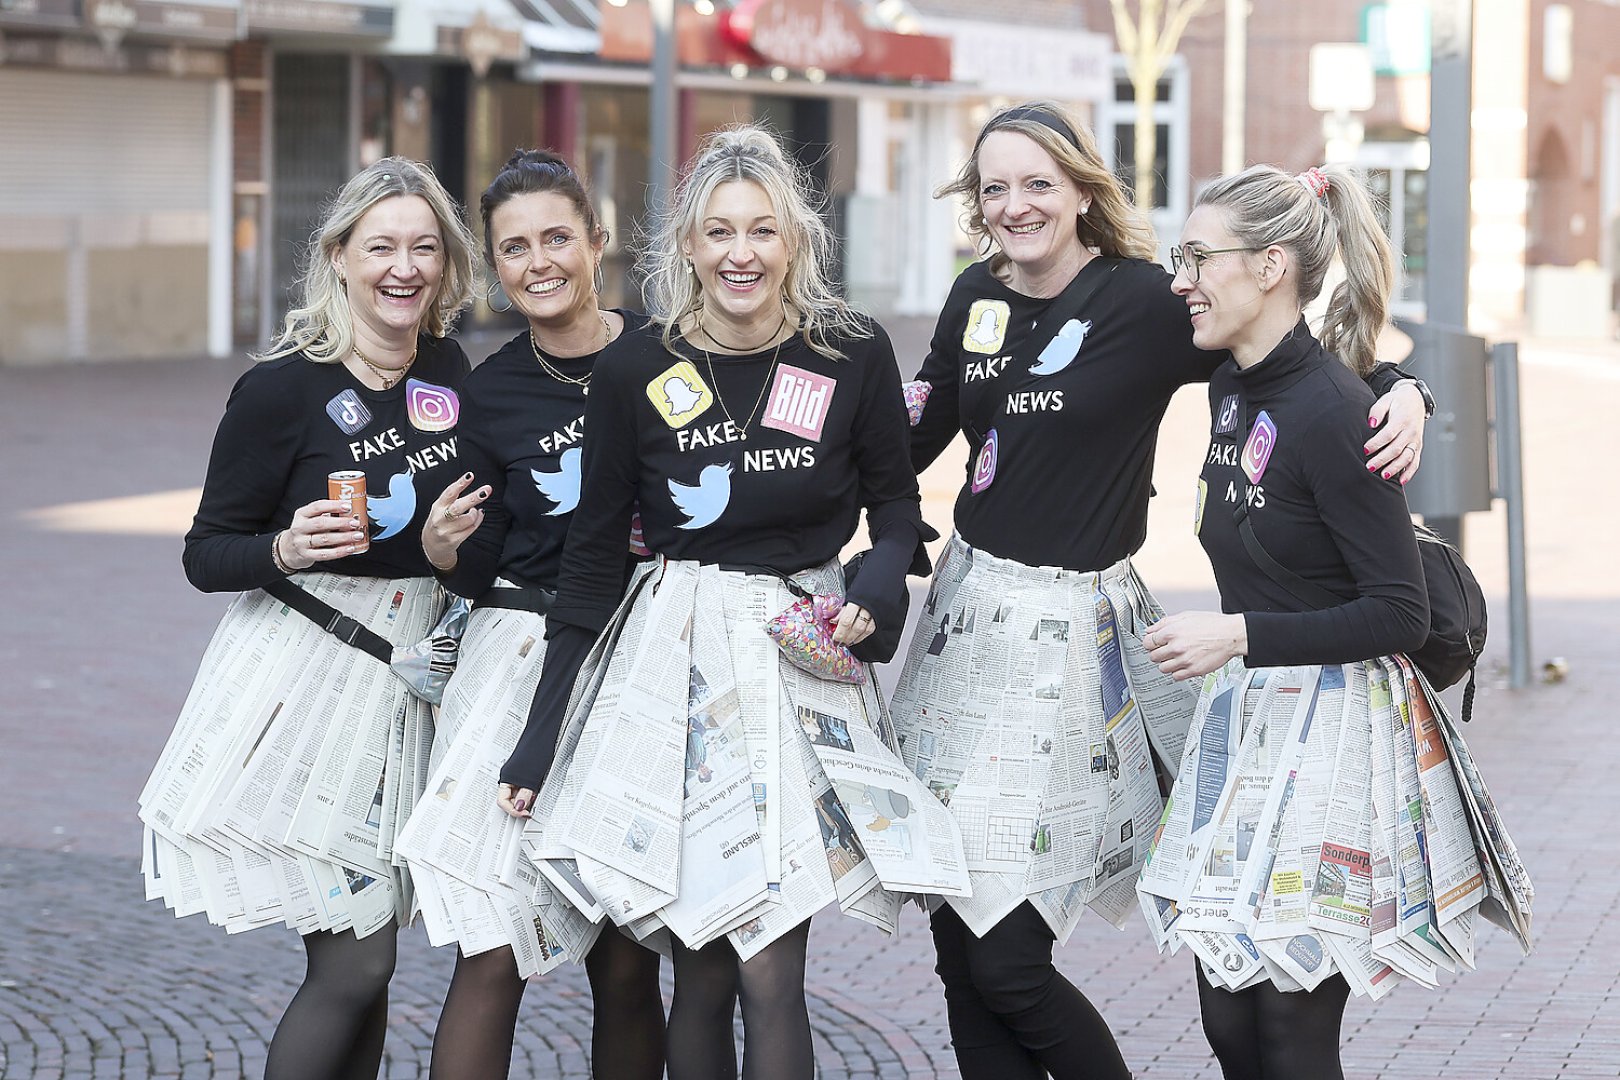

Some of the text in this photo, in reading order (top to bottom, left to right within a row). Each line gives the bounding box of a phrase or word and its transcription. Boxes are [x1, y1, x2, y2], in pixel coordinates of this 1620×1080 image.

[770, 372, 828, 431] Bild
[1006, 390, 1064, 415] NEWS
[349, 427, 405, 462] FAKE
[539, 414, 584, 453] FAK
[676, 419, 740, 452] FAKE
[405, 436, 458, 473] NEW
[743, 446, 815, 472] NEWS
[1224, 480, 1266, 509] NWS
[708, 790, 727, 805] dem
[679, 800, 710, 823] Spende
[343, 830, 377, 848] nenstädte
[720, 831, 761, 860] RIESLAND
[1324, 846, 1370, 868] Sonderp
[1183, 906, 1230, 920] ener So
[1291, 938, 1321, 963] NOCHMALS
